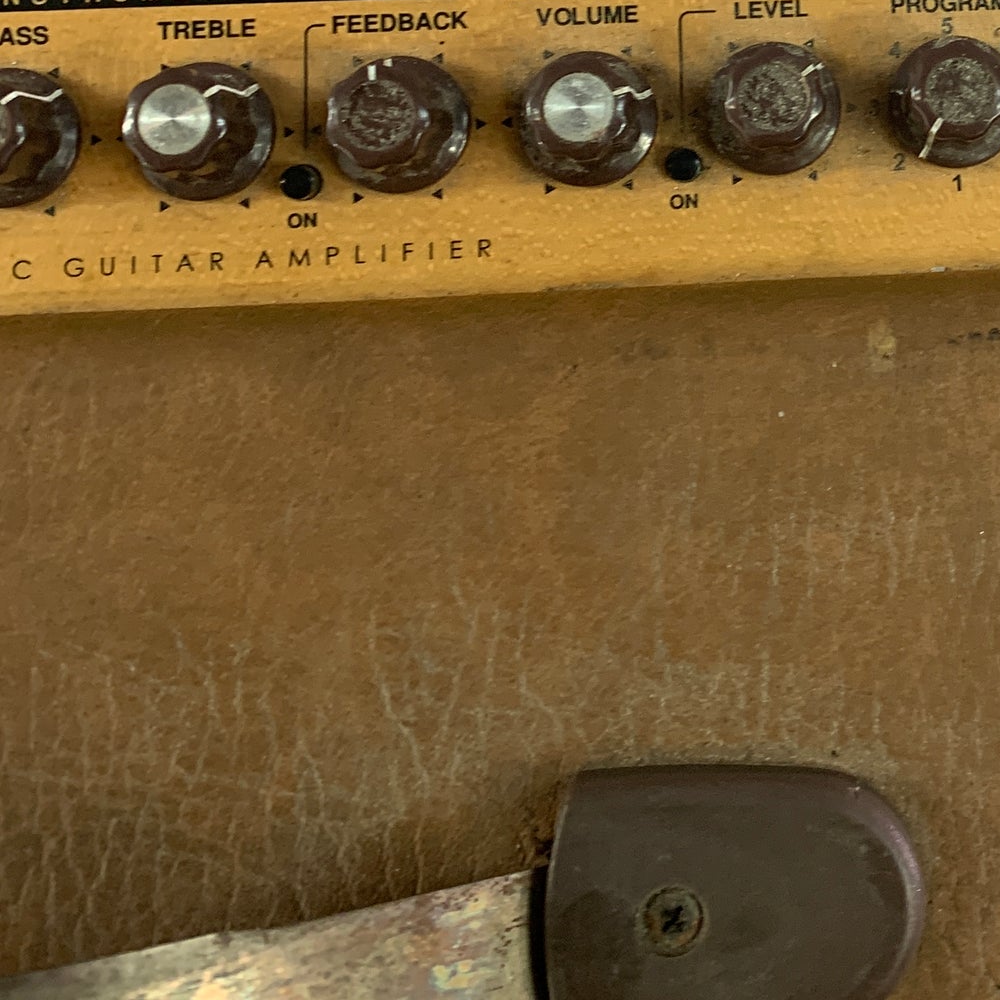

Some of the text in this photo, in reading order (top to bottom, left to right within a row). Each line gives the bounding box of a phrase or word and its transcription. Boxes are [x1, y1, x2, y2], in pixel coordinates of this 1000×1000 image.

[536, 4, 639, 25] VOLUME
[734, 0, 809, 20] LEVEL
[157, 18, 257, 40] TREBLE
[331, 11, 468, 34] FEEDBACK
[941, 17, 953, 34] 5
[893, 152, 906, 171] 2
[951, 173, 963, 192] 1
[669, 193, 699, 210] ON
[287, 212, 318, 229] ON
[63, 252, 224, 278] GUITAR
[255, 238, 492, 269] AMPLIFIER
